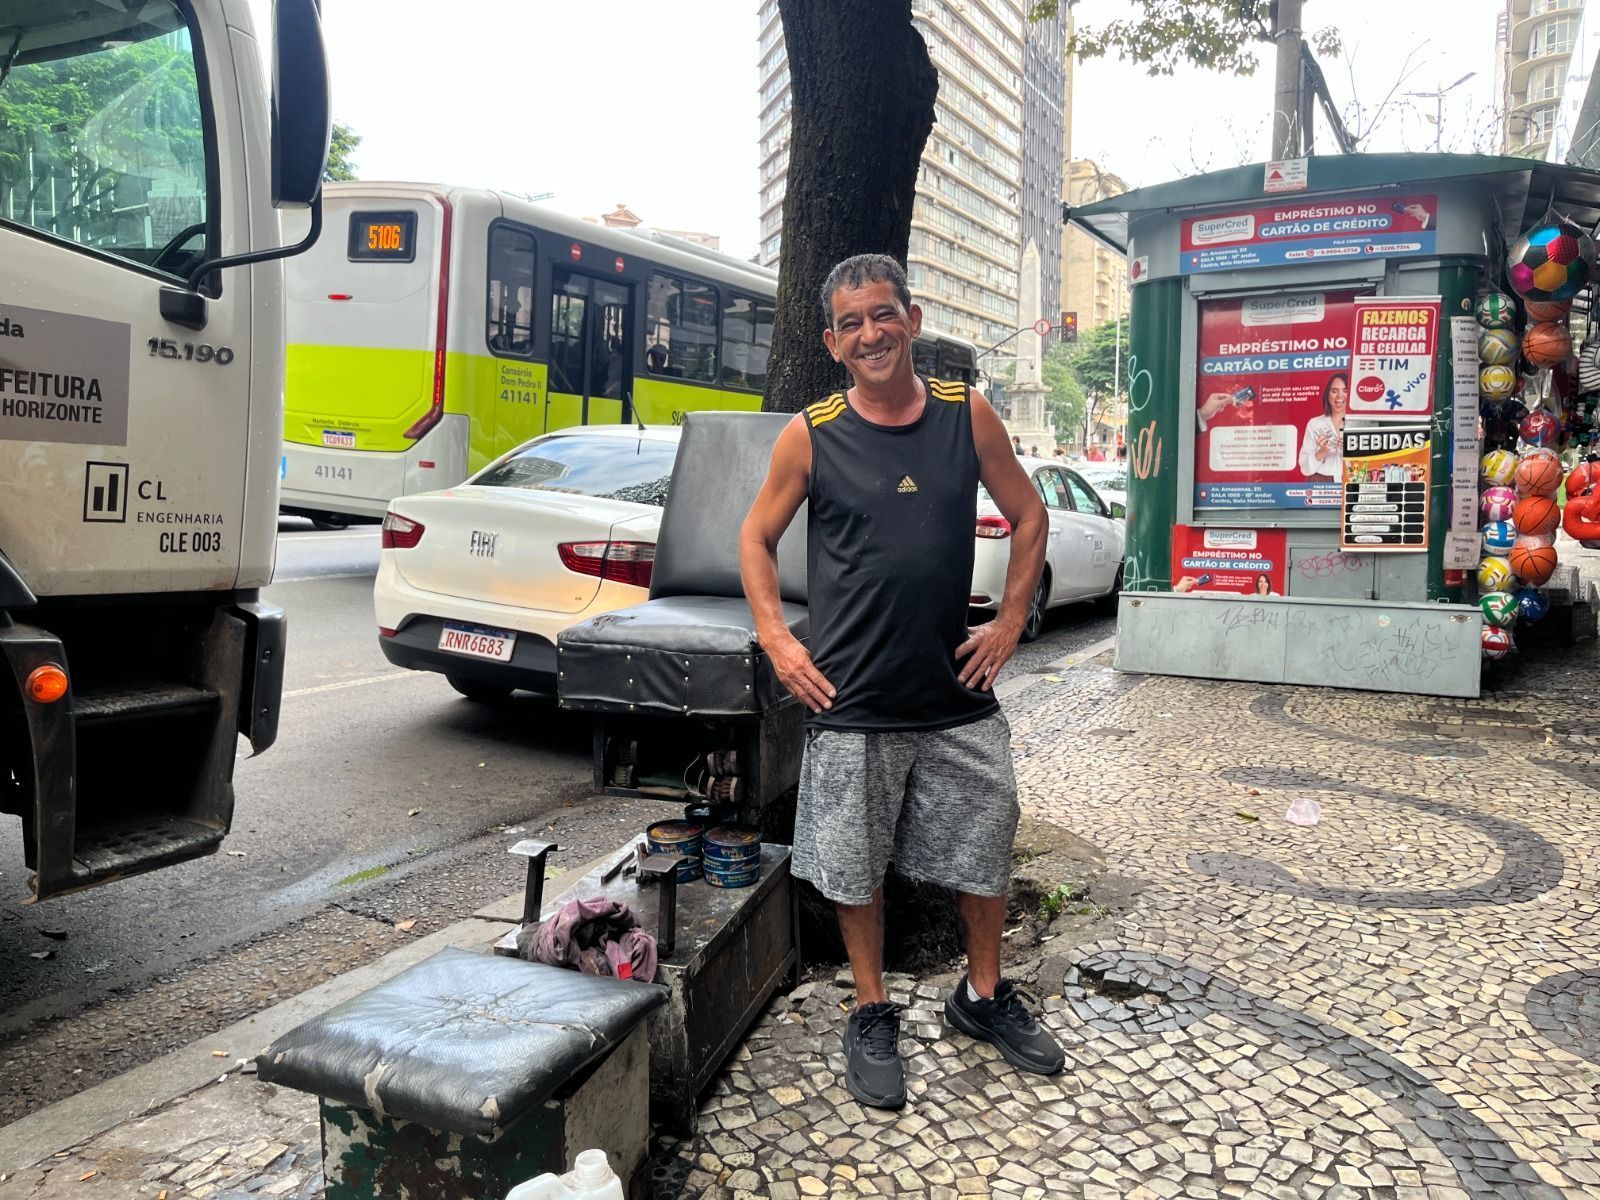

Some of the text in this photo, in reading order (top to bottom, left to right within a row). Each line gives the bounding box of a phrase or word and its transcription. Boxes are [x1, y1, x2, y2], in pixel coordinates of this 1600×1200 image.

[1274, 204, 1376, 221] EMPRÉSTIMO NO
[1198, 218, 1248, 232] SuperCred
[1261, 221, 1310, 237] CARTÃO
[1314, 222, 1330, 232] DE
[1333, 218, 1388, 230] CRÉDITO
[369, 225, 400, 249] 5106
[1250, 297, 1317, 311] SuperCred
[1363, 310, 1429, 325] FAZEMOS
[0, 318, 25, 338] da
[1362, 327, 1427, 341] RECARGA
[146, 337, 234, 365] 15.190
[1220, 337, 1347, 355] EMPRÉSTIMO NO
[1361, 343, 1426, 354] DE CELULAR
[502, 365, 532, 377] Consórcio
[1204, 358, 1264, 373] CARTÃO
[1268, 359, 1289, 370] DE
[1378, 359, 1409, 371] TIM
[0, 368, 103, 402] FEITURA
[501, 376, 516, 385] Dom
[518, 378, 536, 388] Pedro
[1403, 372, 1427, 393] vivo
[501, 390, 537, 405] 41141
[2, 398, 103, 424] HORIZONTE
[1347, 432, 1426, 451] BEBIDAS
[315, 465, 352, 480] 41141
[137, 512, 224, 525] ENGENHARIA
[159, 532, 221, 553] CLE 003
[1209, 531, 1252, 540] SuperCred
[471, 531, 499, 557] FIAT
[1193, 551, 1247, 559] EMPRÉSTIMO
[1183, 560, 1271, 570] CARTÃO DE CRÉDITO
[446, 631, 504, 656] RNR6G83
